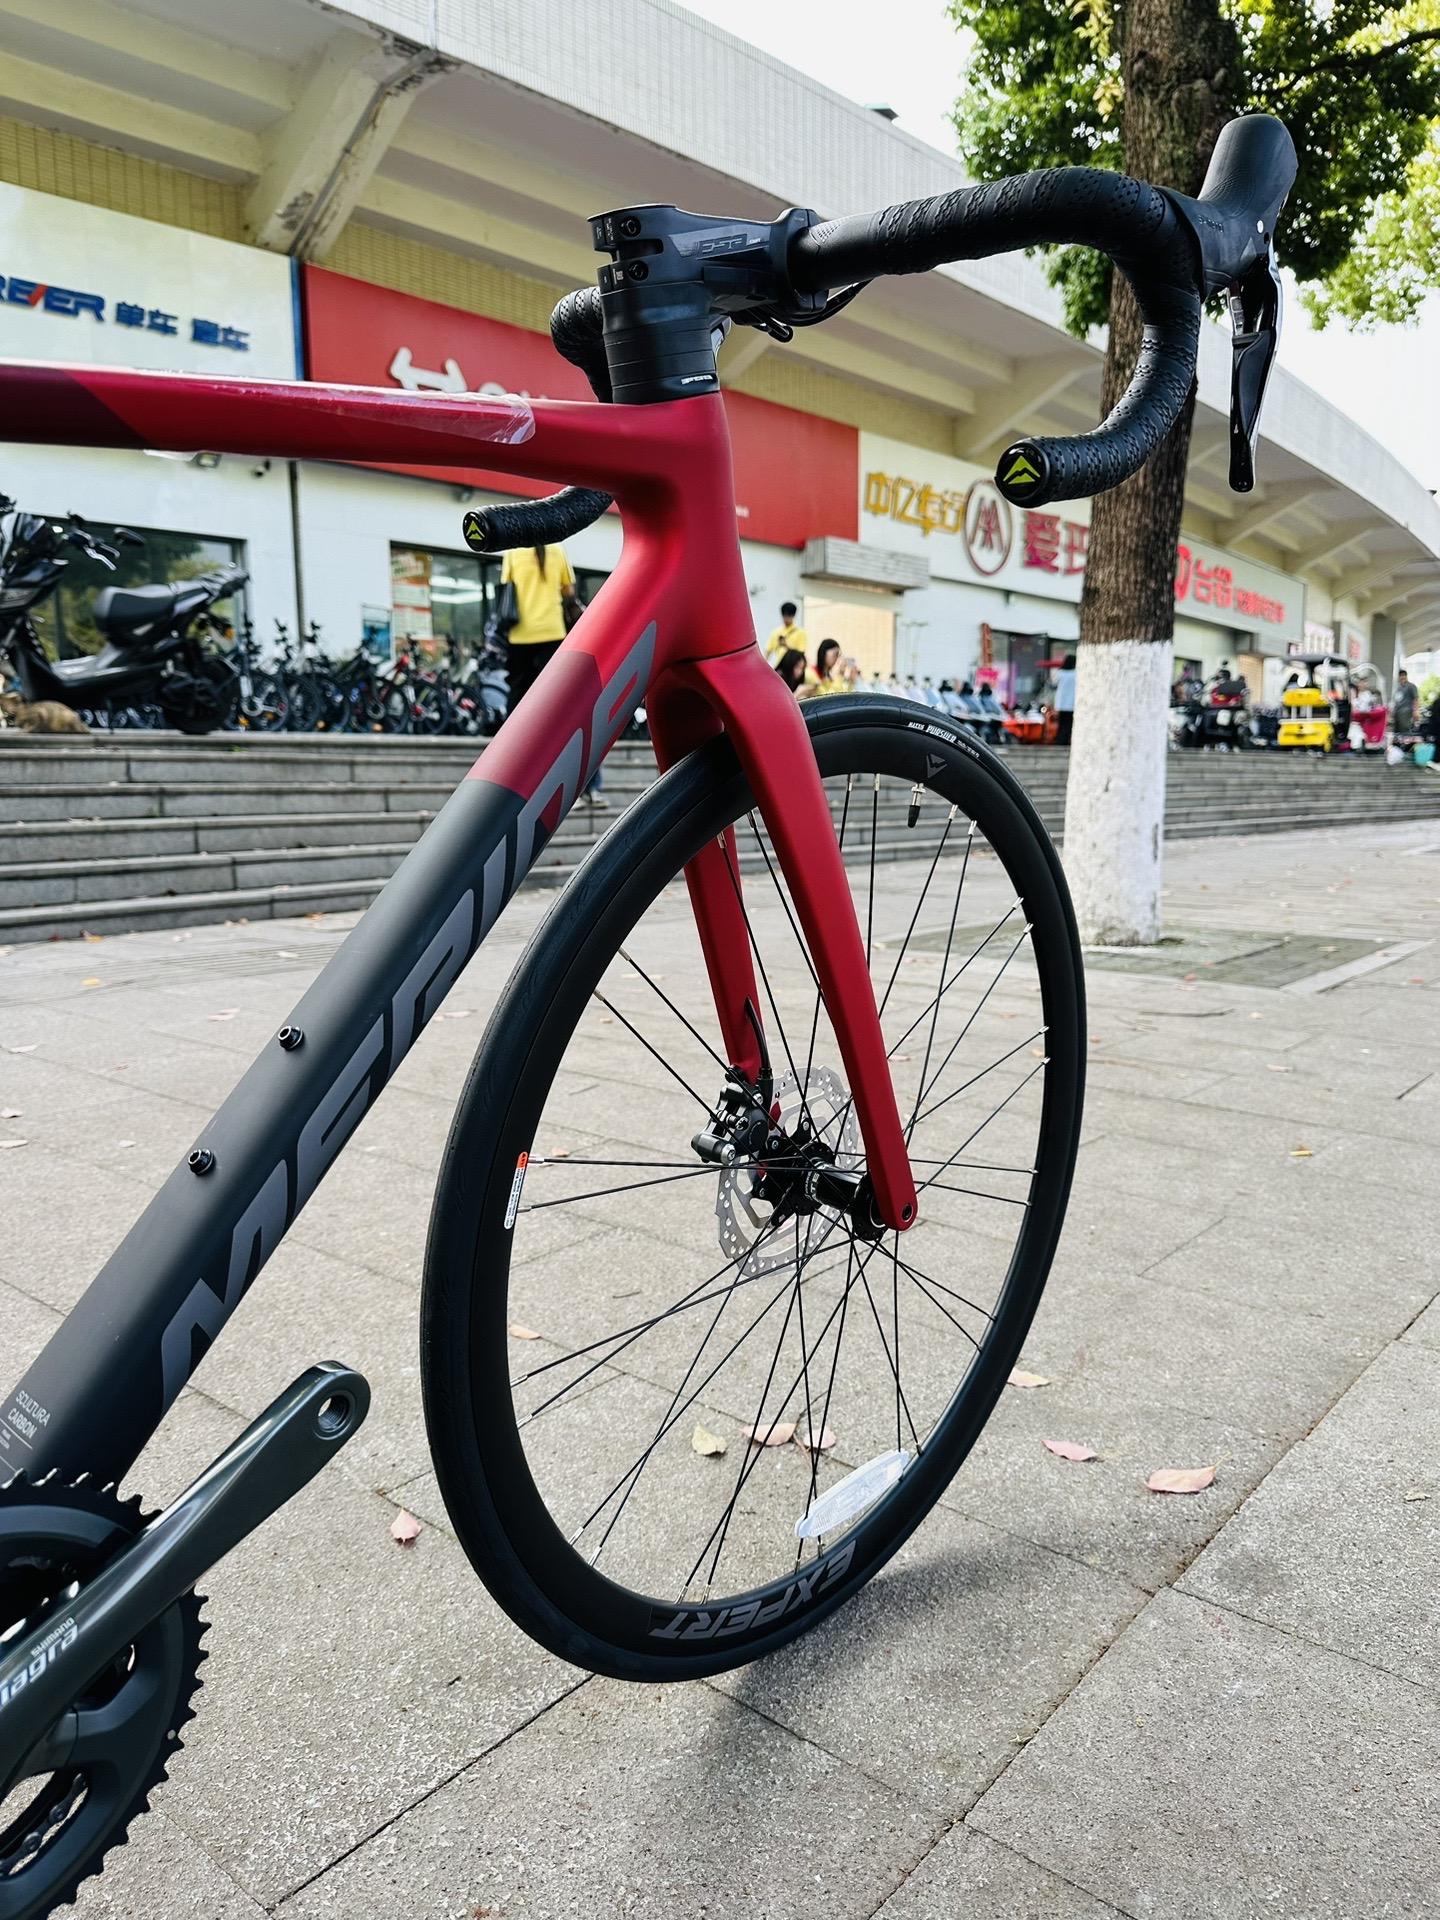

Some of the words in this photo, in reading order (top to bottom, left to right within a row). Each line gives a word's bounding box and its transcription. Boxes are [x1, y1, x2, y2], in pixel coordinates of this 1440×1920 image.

[0, 275, 105, 323] EVER
[7, 1407, 38, 1439] CARBON
[15, 1390, 51, 1427] SCULTURA
[648, 1538, 857, 1640] EXPERT
